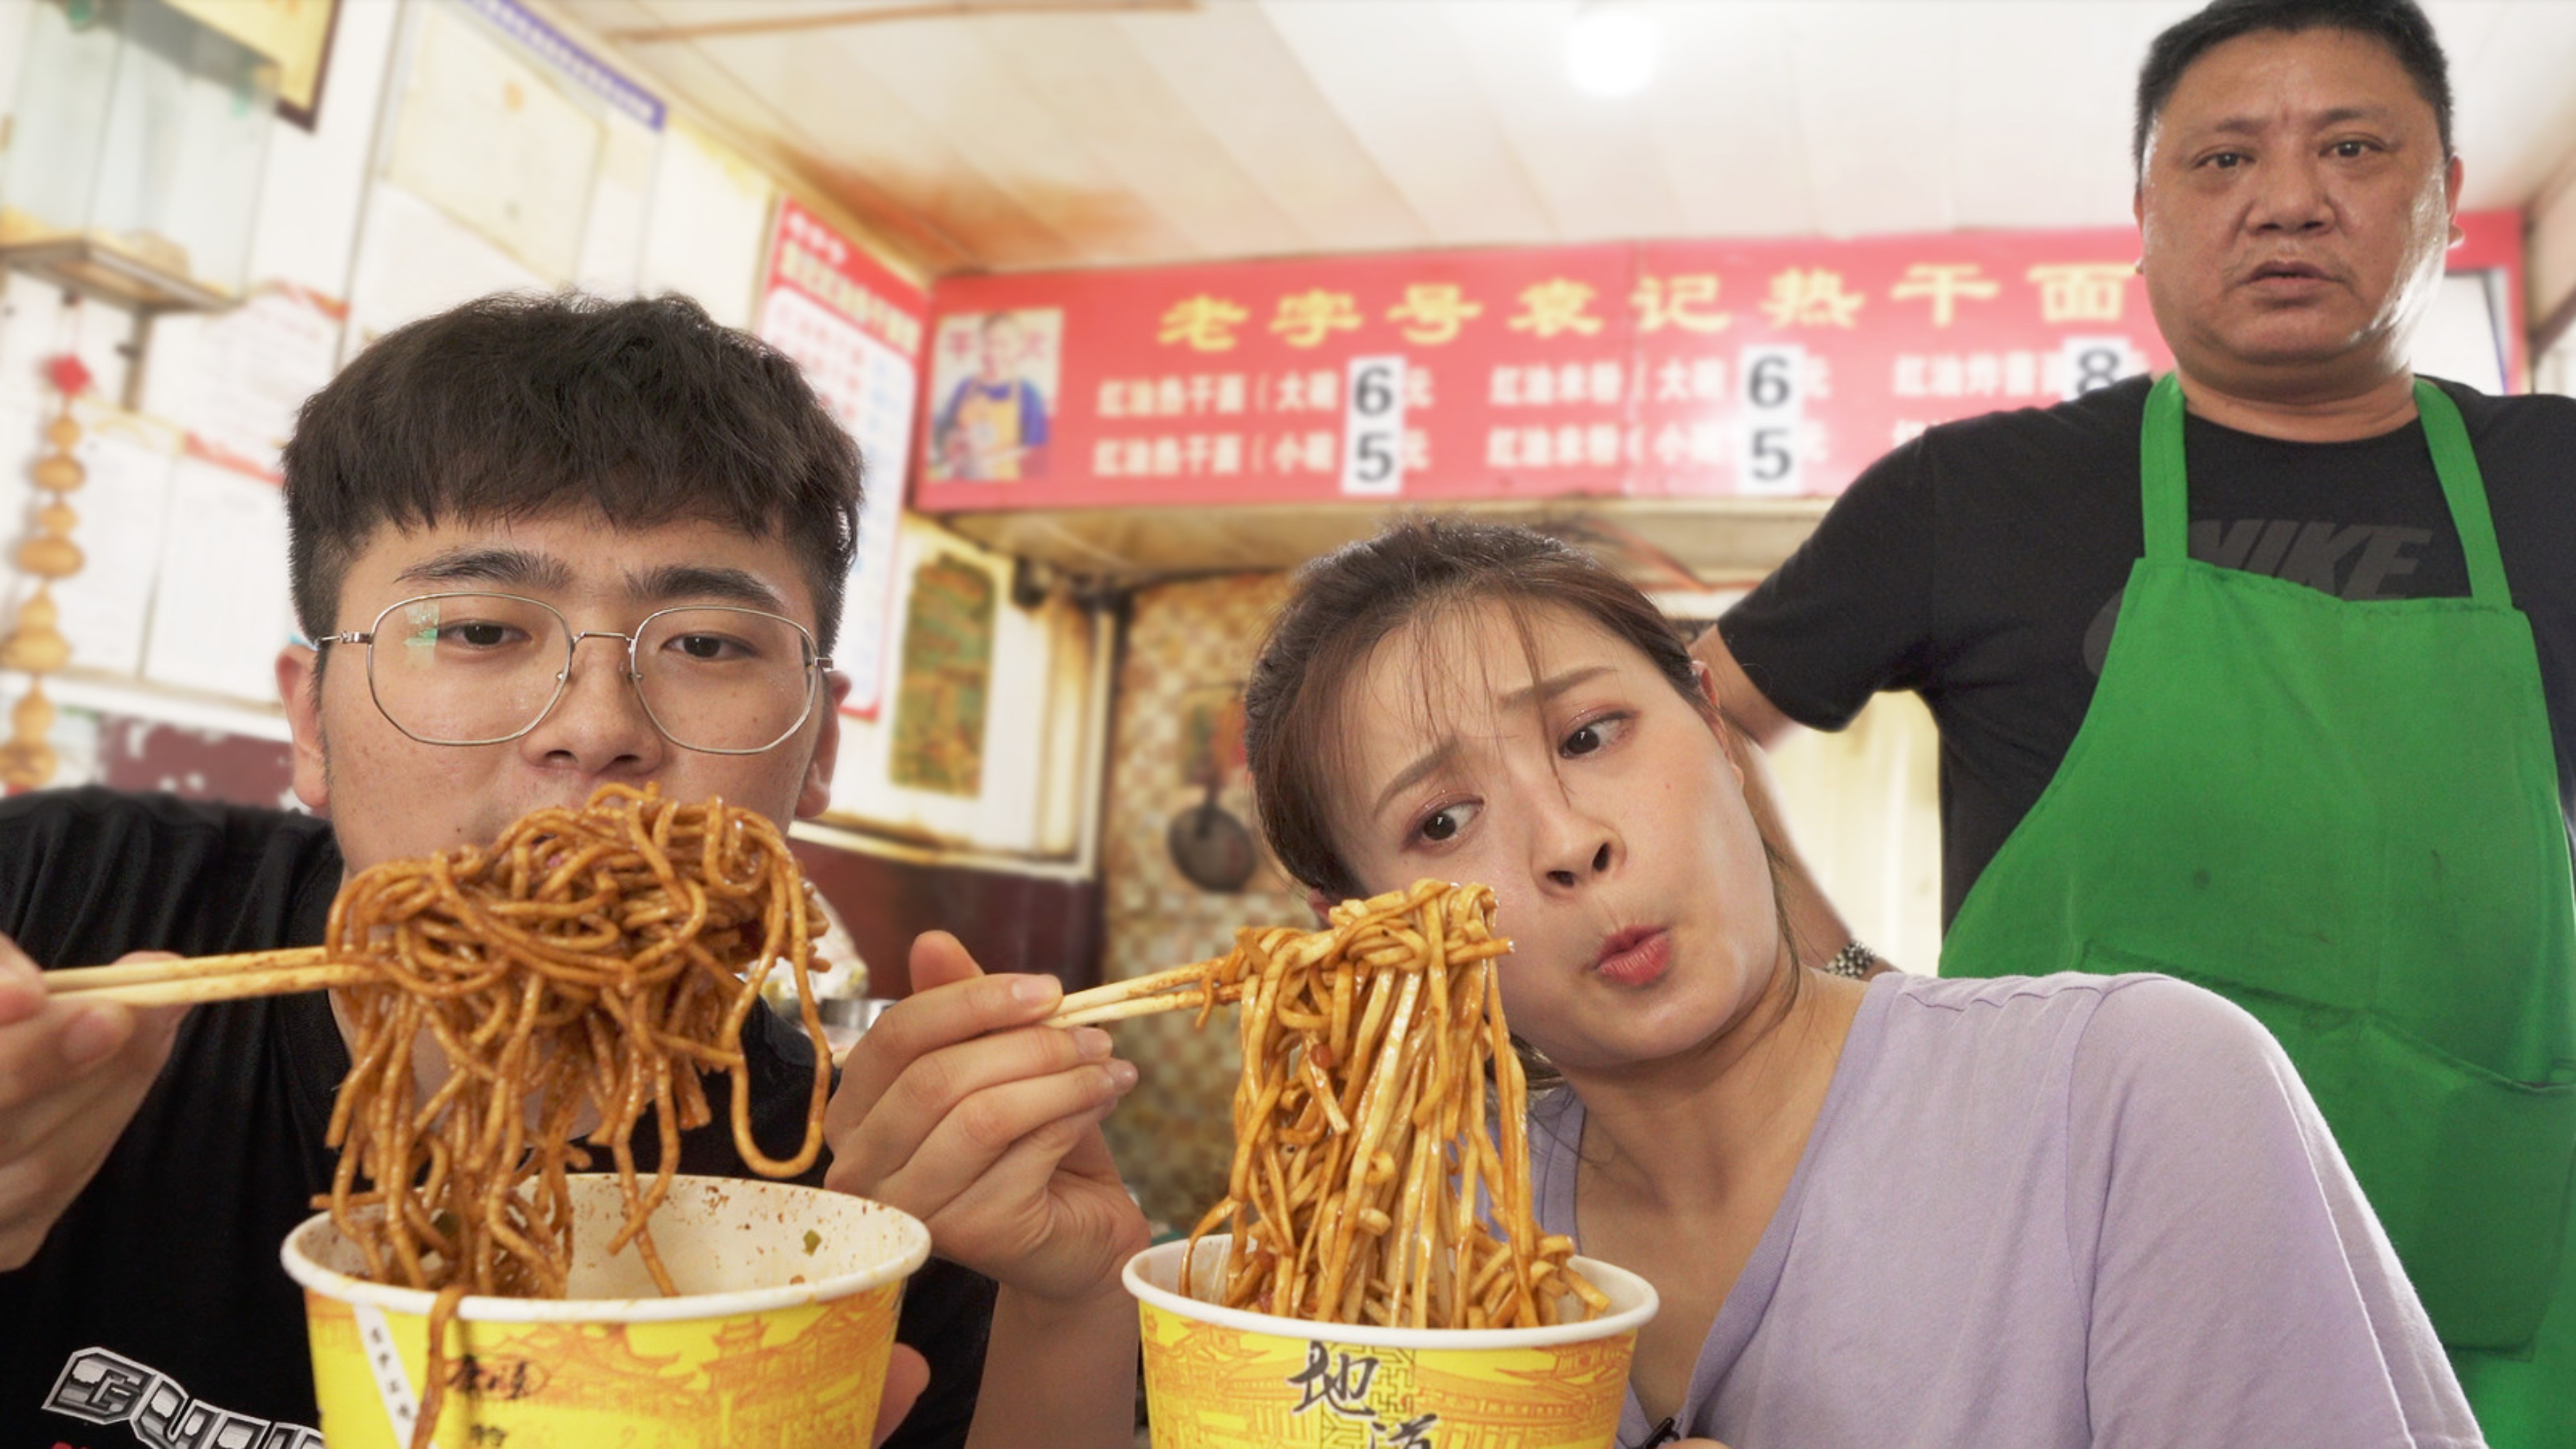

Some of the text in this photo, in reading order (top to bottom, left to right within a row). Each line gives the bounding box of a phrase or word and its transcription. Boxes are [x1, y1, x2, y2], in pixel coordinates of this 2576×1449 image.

[1157, 264, 2140, 352] 老字号袁记热干面
[1355, 366, 1393, 416] 6
[1748, 354, 1790, 408] 6
[2076, 347, 2121, 400] 8
[1355, 432, 1393, 482] 5
[1752, 428, 1792, 482] 5
